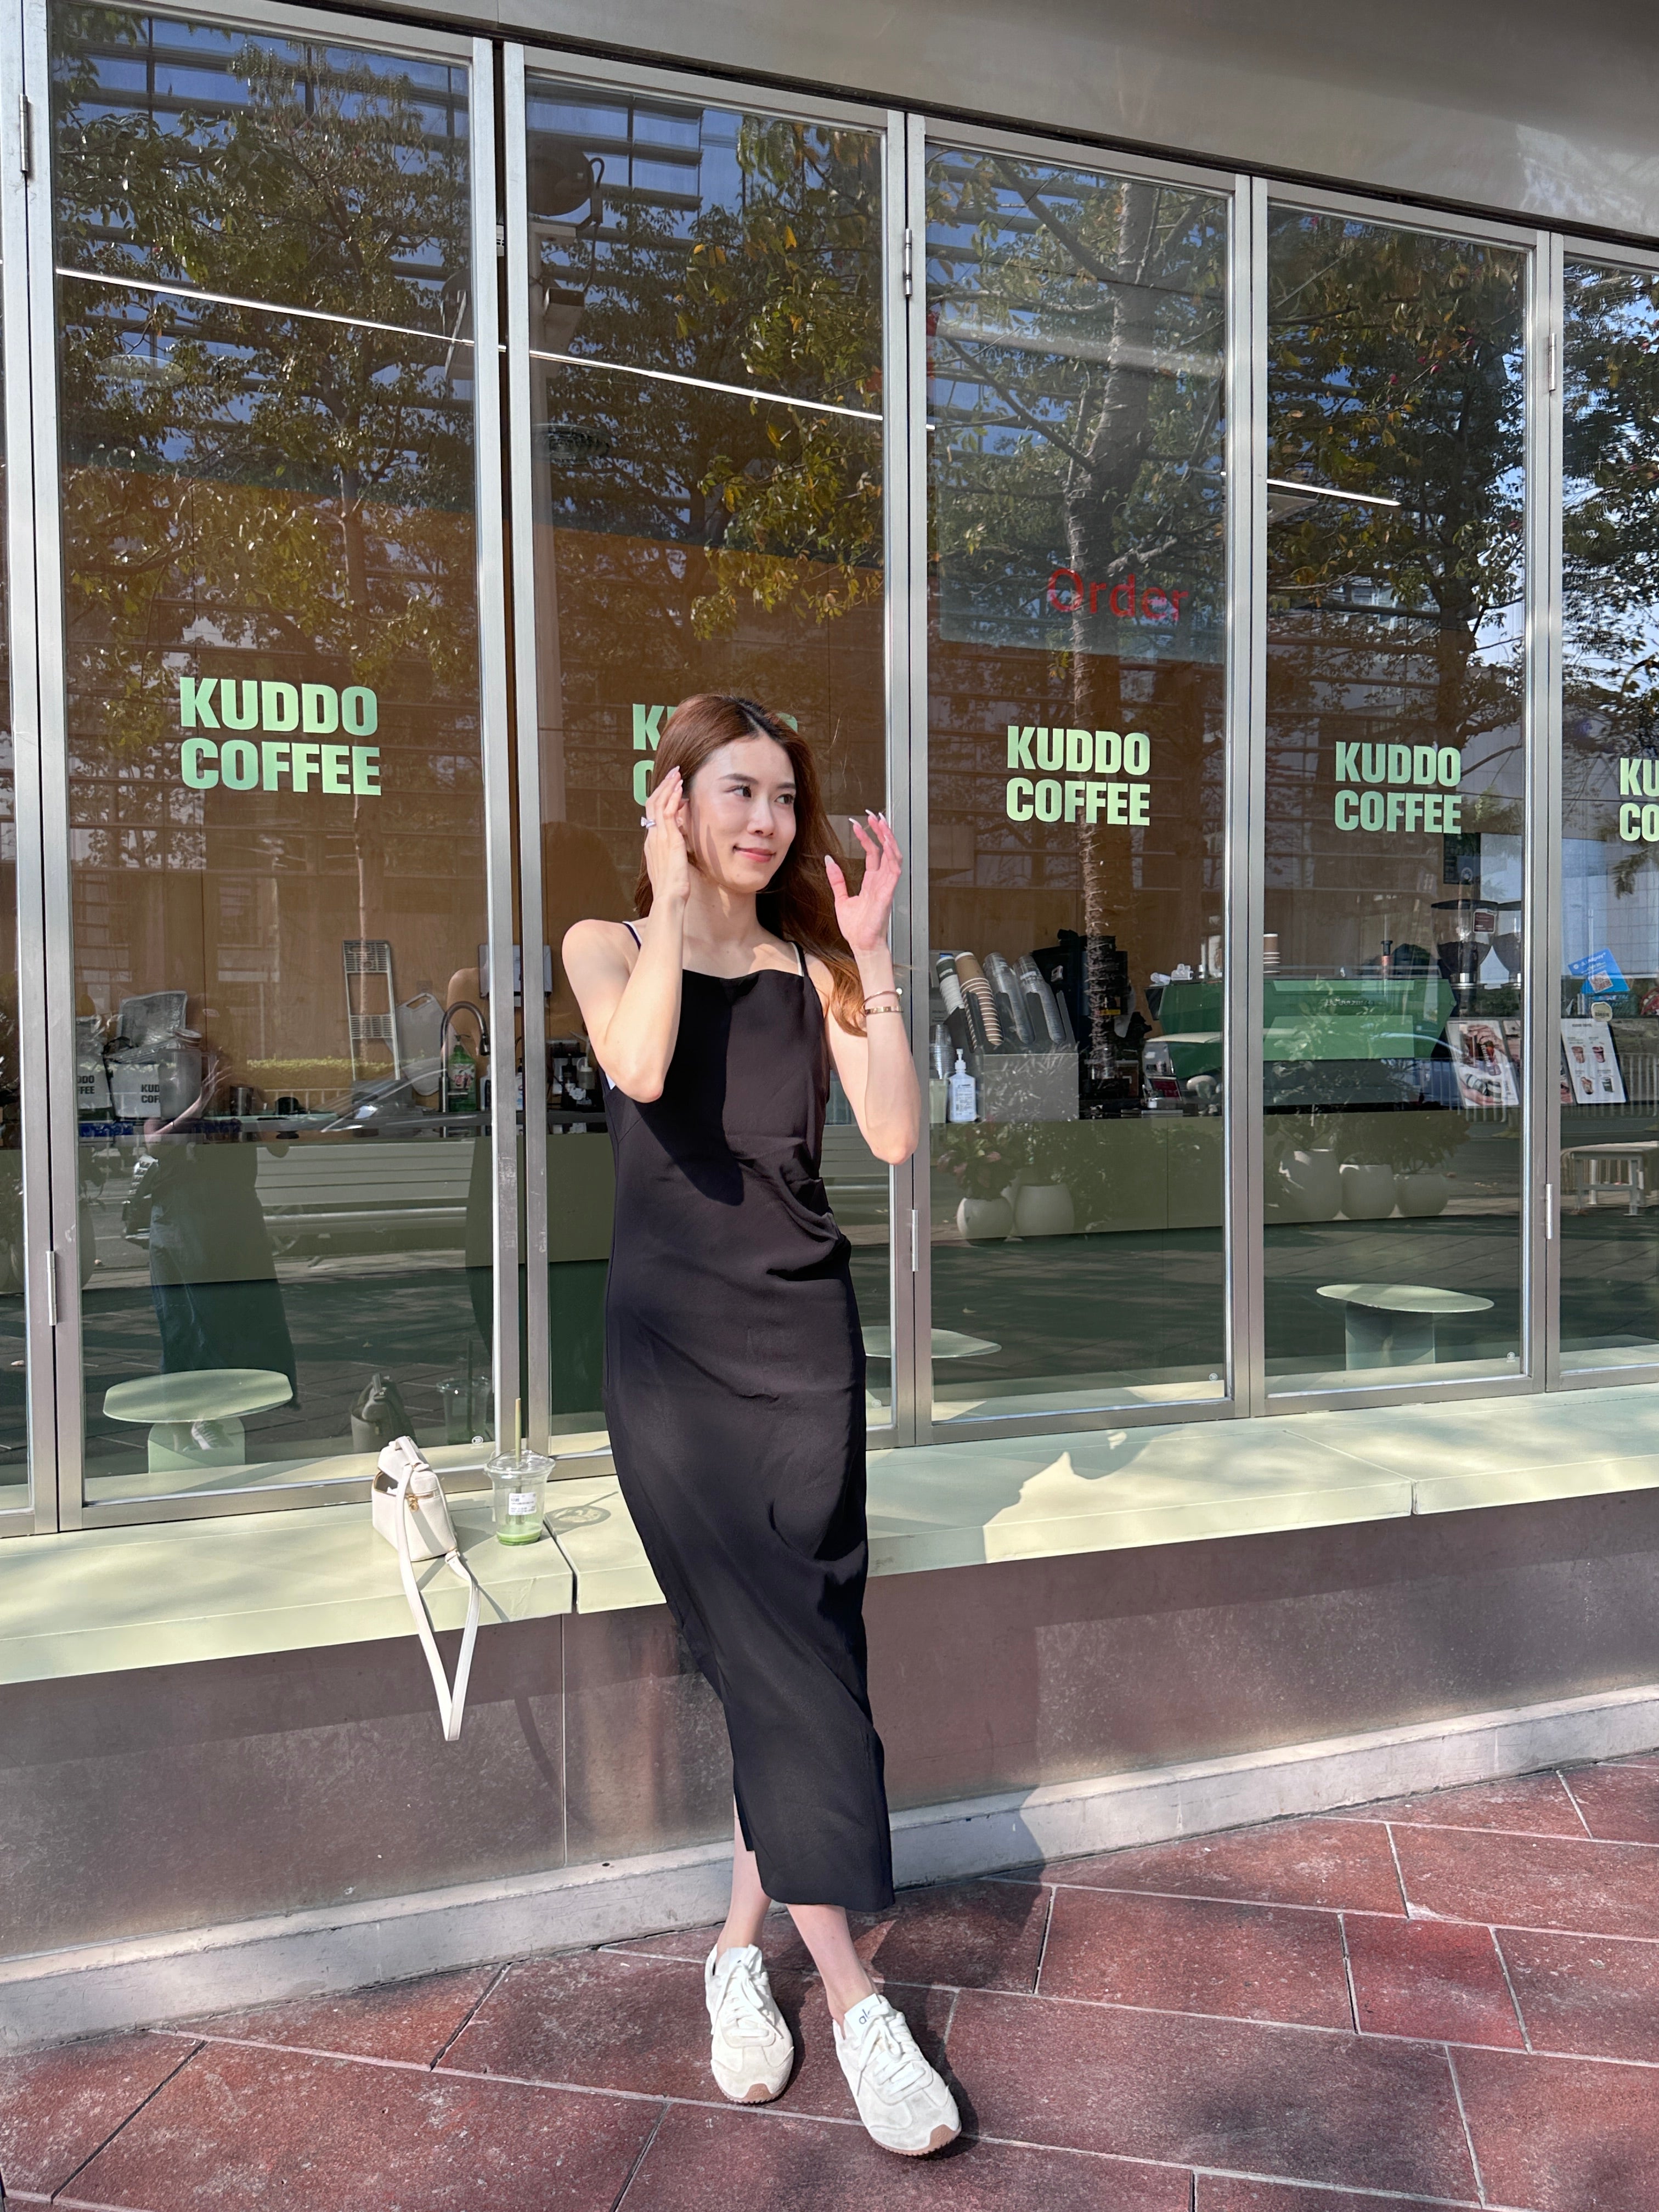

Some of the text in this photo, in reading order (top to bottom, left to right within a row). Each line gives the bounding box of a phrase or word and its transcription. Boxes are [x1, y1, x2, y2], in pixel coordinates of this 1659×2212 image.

[1047, 567, 1189, 621] Order
[180, 676, 378, 736] KUDDO
[180, 738, 381, 795] COFFEE
[1007, 725, 1150, 776] KUDDO
[1335, 741, 1461, 787] KUDDO
[1006, 777, 1150, 826] COFFEE
[1335, 789, 1462, 834] COFFEE
[859, 2008, 870, 2024] al
